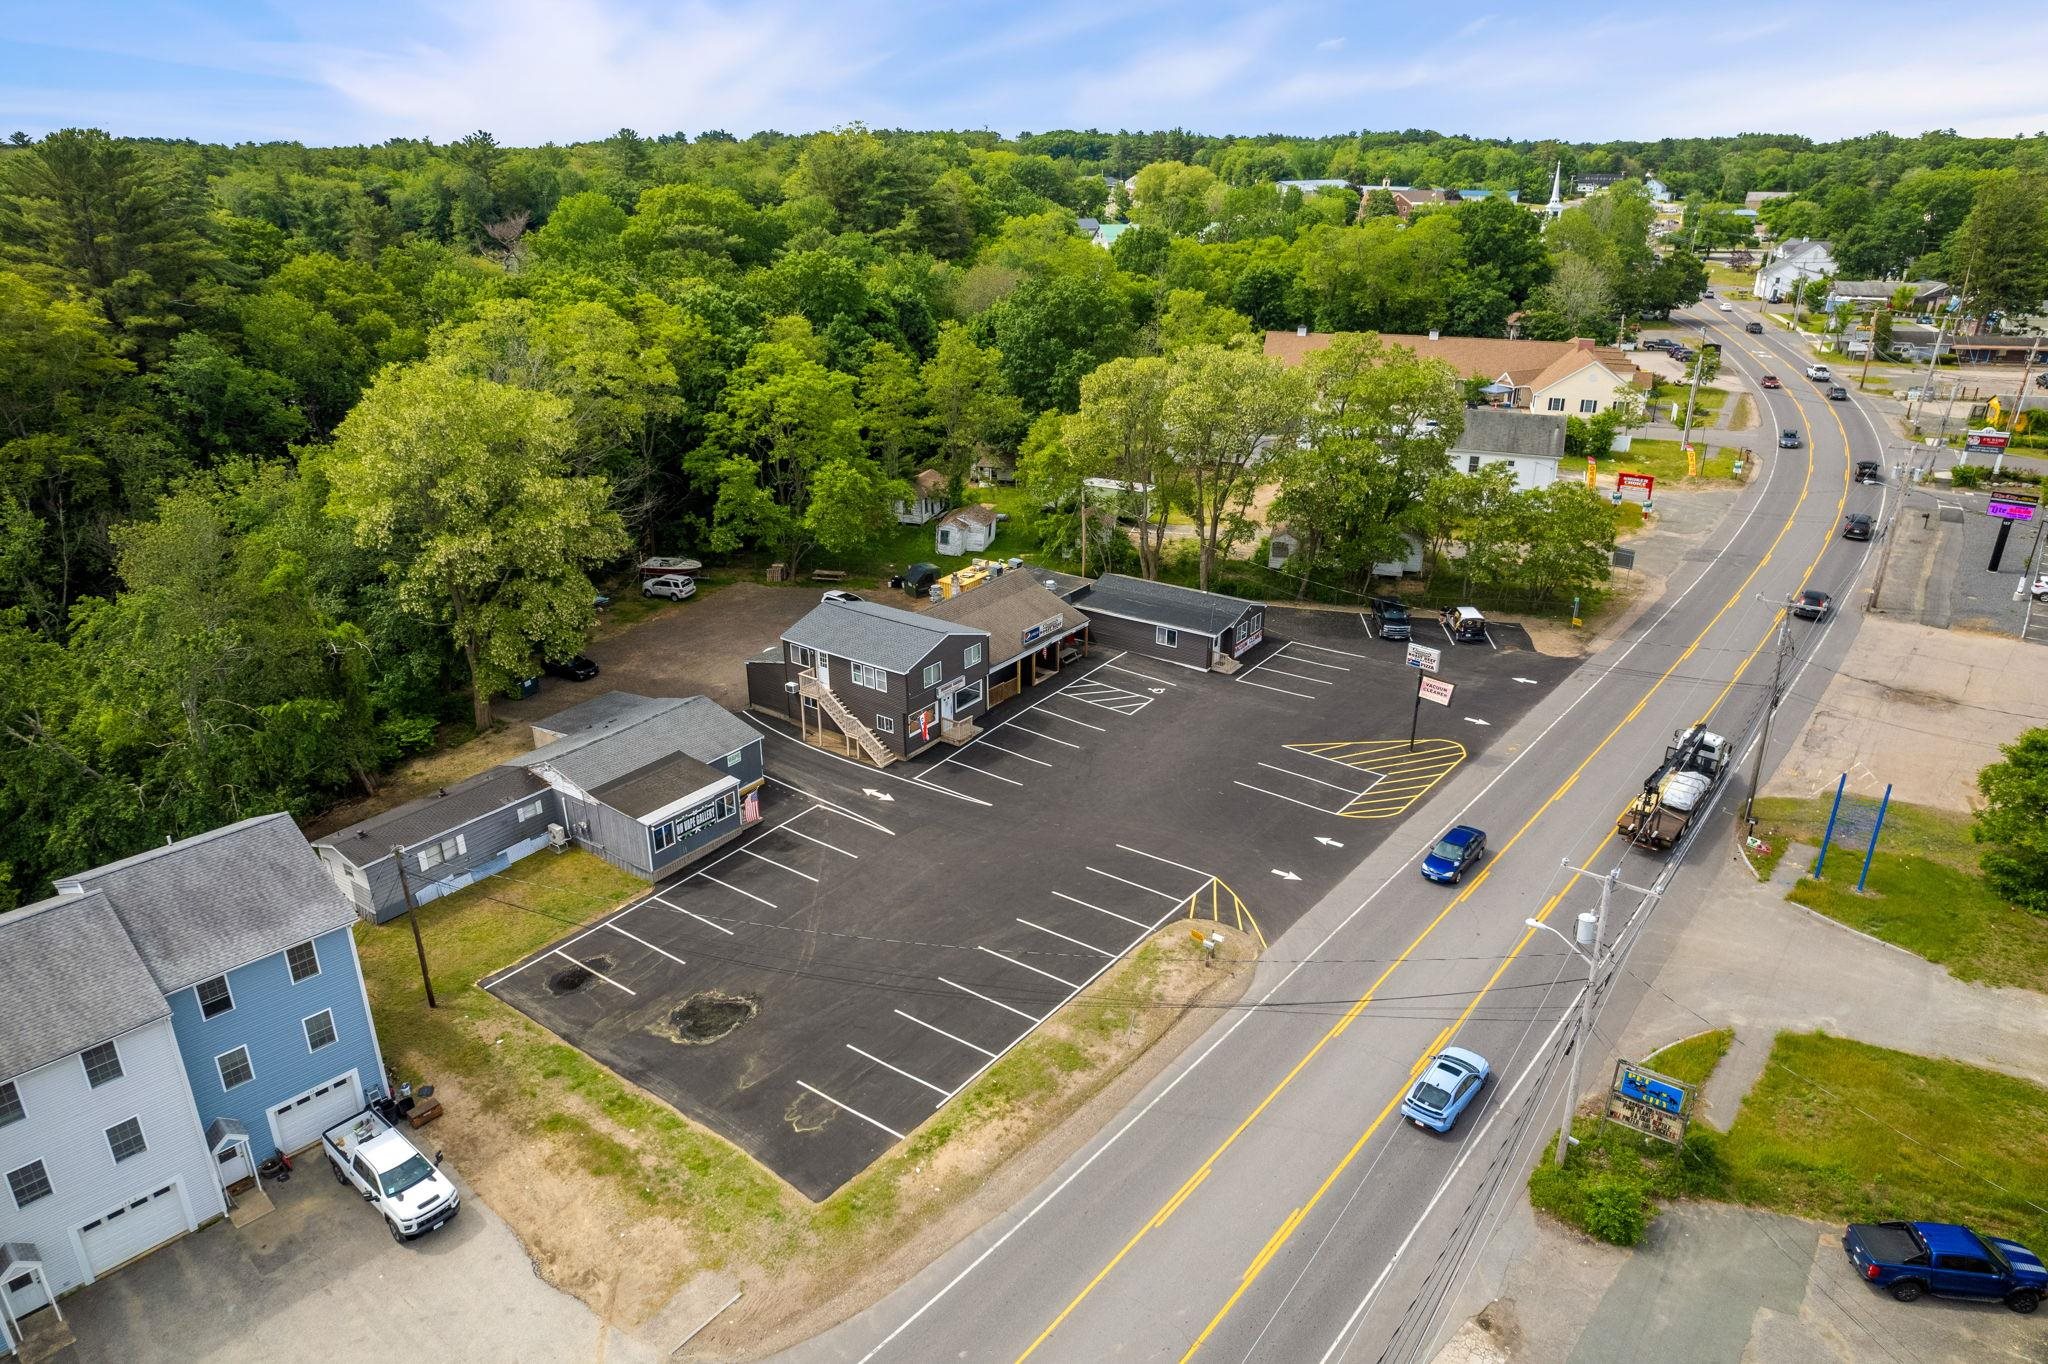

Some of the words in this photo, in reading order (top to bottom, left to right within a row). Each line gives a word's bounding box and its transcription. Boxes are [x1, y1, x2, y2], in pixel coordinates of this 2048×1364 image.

[1420, 662, 1435, 670] PIZZA
[1423, 687, 1448, 698] CLEANER
[1426, 682, 1448, 692] VACUUM
[1628, 1072, 1650, 1084] PET
[1642, 1094, 1667, 1108] CITY
